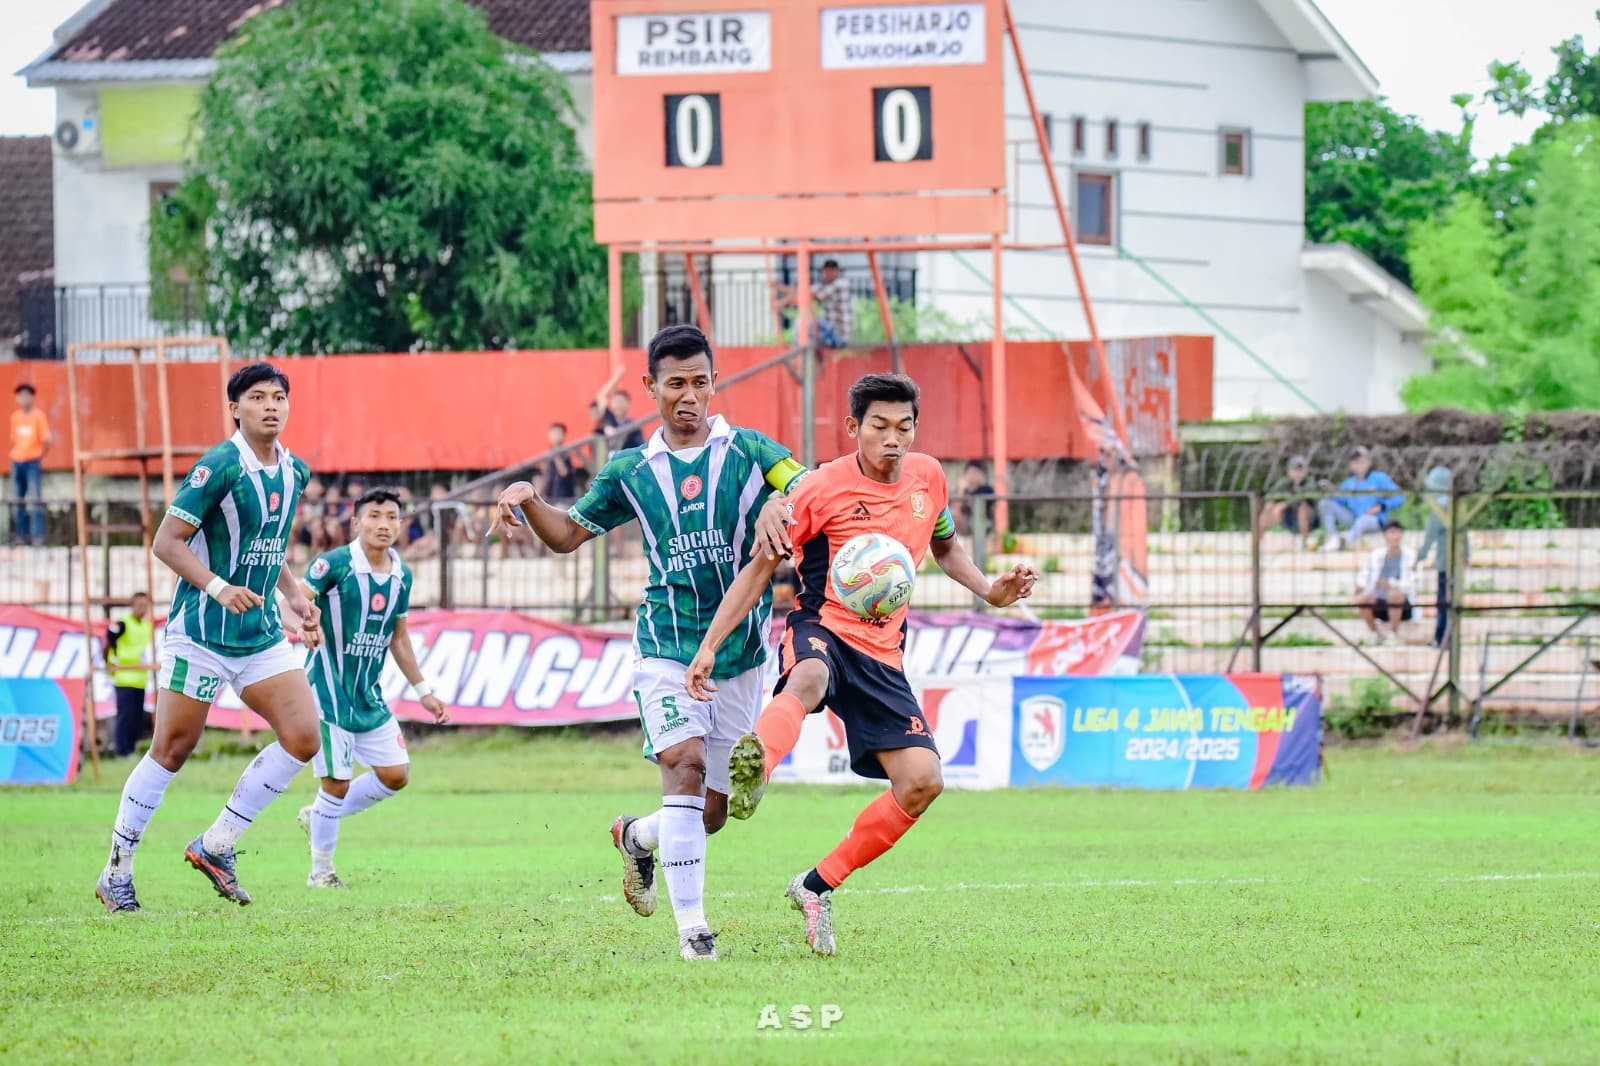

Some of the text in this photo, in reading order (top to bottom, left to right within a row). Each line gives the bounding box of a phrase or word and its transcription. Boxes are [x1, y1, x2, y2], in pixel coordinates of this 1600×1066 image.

[646, 18, 744, 46] PSIR
[835, 11, 971, 37] PERSIHARJO
[638, 48, 752, 67] REMBANG
[844, 41, 963, 60] SUKOHARJO
[675, 94, 713, 168] 0
[881, 89, 922, 162] 0
[680, 502, 705, 514] JUNIOR
[668, 528, 728, 555] SOCIAL
[665, 546, 734, 573] JUSTICE
[196, 675, 219, 699] 22
[662, 695, 680, 721] 5
[1072, 706, 1297, 732] LIGA 4 JAWA TENGAH
[1125, 737, 1240, 761] 2024/2025
